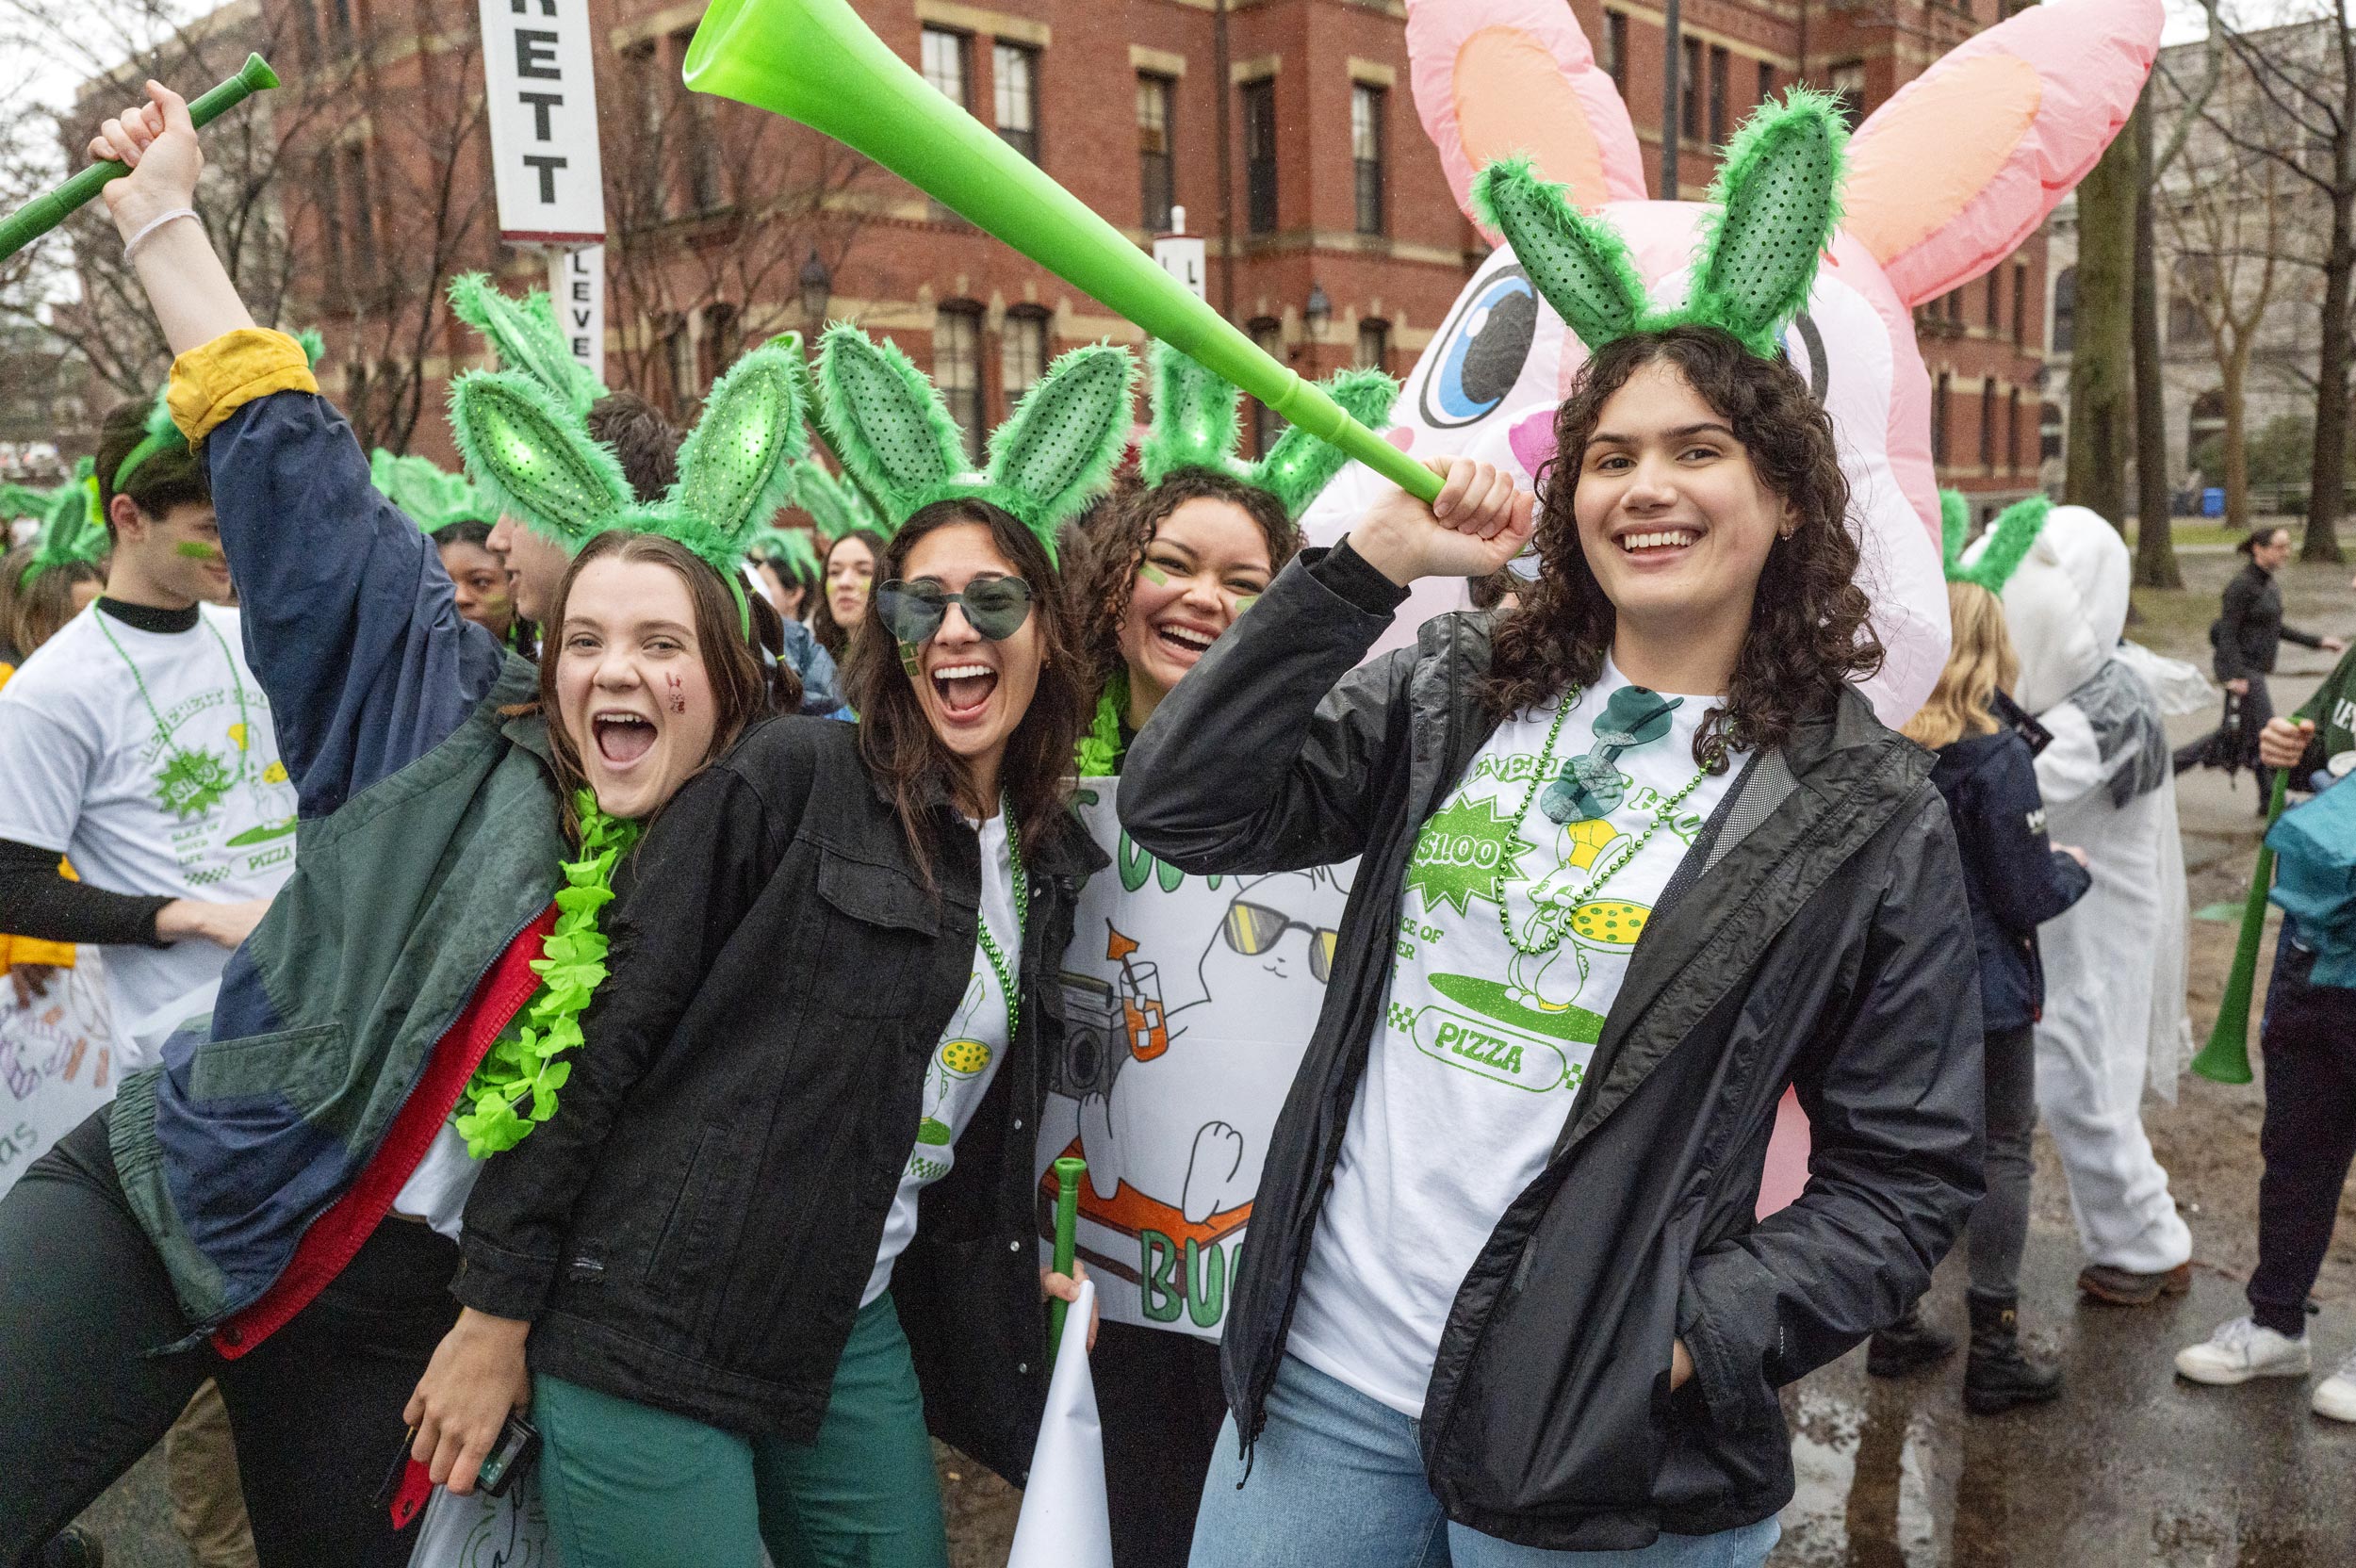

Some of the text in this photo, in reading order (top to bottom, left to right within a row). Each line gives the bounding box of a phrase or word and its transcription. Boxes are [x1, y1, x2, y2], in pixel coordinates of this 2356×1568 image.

[248, 845, 292, 871] PIZZA
[1415, 830, 1500, 870] $1.00
[1419, 925, 1445, 944] OF
[1434, 1021, 1525, 1074] PIZZA
